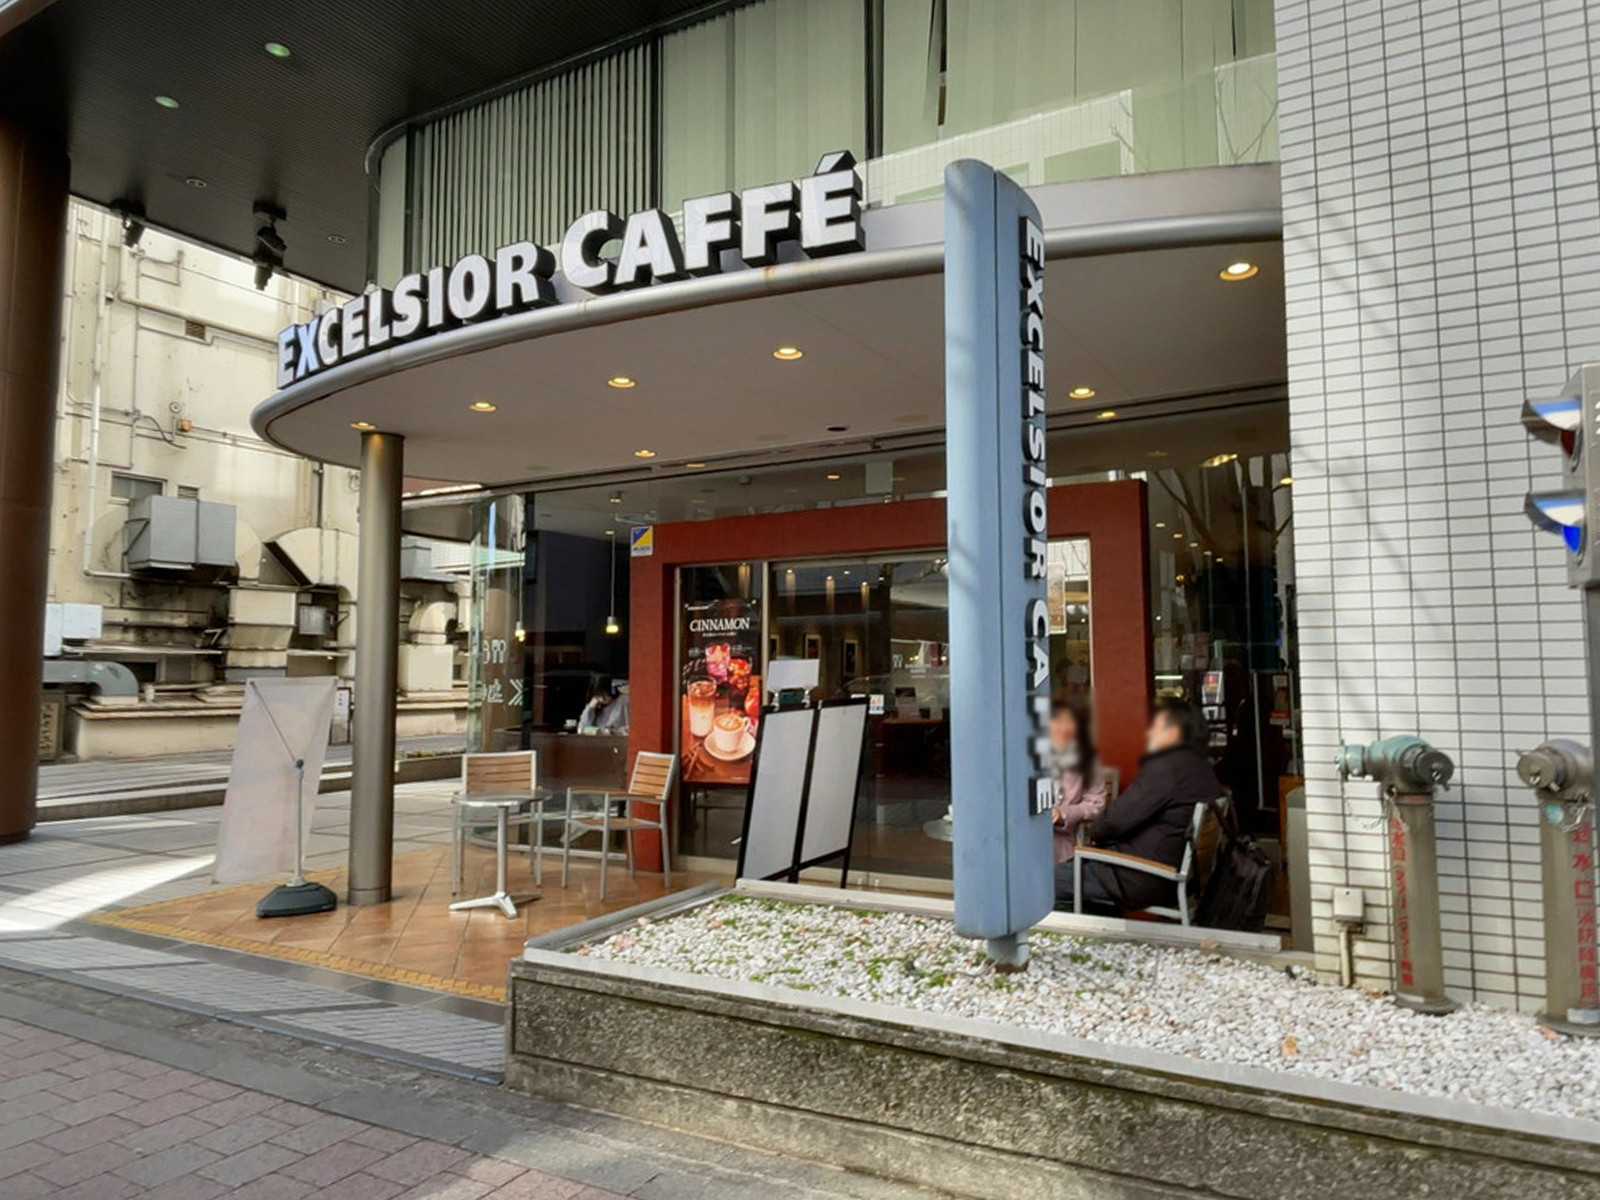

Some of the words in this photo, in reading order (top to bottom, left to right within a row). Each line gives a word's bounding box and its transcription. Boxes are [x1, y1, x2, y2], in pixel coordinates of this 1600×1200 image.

[277, 239, 548, 389] EXCELSIOR
[560, 150, 863, 292] CAFFÉ
[1020, 216, 1047, 579] EXCELSIOR
[689, 616, 751, 632] CINNAMON
